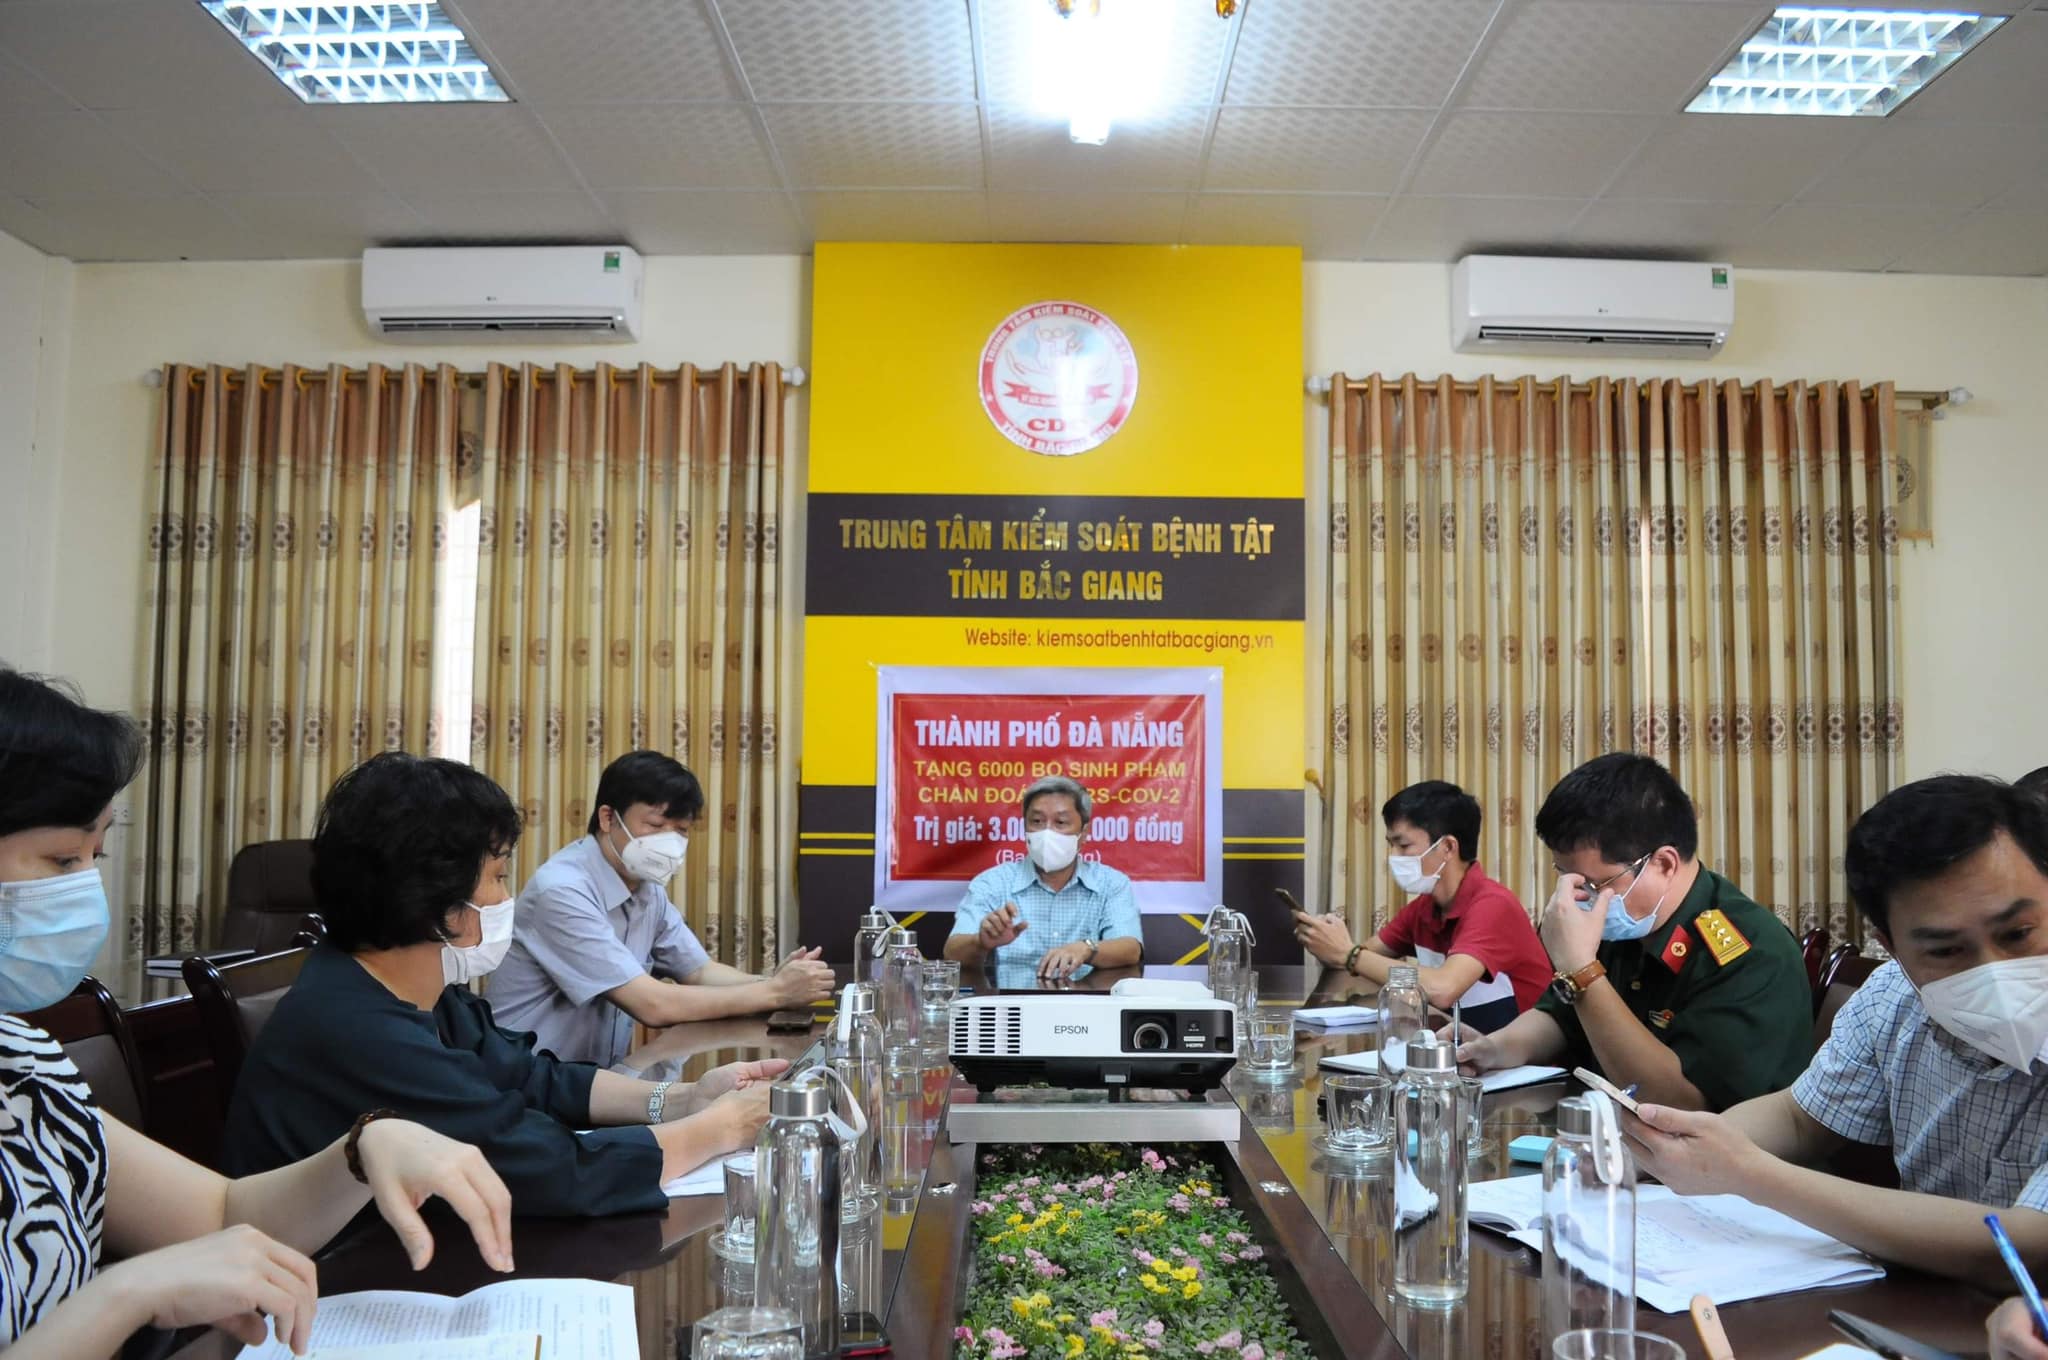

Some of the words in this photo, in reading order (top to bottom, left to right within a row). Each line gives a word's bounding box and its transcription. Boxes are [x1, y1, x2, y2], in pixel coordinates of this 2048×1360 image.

[839, 519, 927, 549] TRUNG
[936, 513, 992, 550] TÂM
[1002, 508, 1069, 551] KIỂM
[1078, 515, 1143, 552] SOÁT
[1152, 516, 1222, 559] BỆNH
[1230, 517, 1275, 560] TẬT
[948, 557, 1008, 599] TỈNH
[1019, 560, 1072, 600] BẮC
[1082, 570, 1163, 601] GIANG
[965, 628, 1031, 647] Website:
[1037, 629, 1274, 653] kiemsoatbenhtatbacgiang.vn
[914, 715, 1001, 747] THÀNH
[1008, 712, 1061, 748] PHỐ
[1068, 715, 1104, 748] ĐÀ
[1111, 711, 1184, 748] NẴNG
[978, 761, 1025, 778] 6000
[1069, 761, 1118, 778] SINH
[984, 784, 1026, 804] ĐOÁ
[913, 815, 940, 847] Trị
[945, 815, 983, 844] giá:
[1134, 812, 1183, 845] đồng
[1054, 1025, 1089, 1034] EPSON
